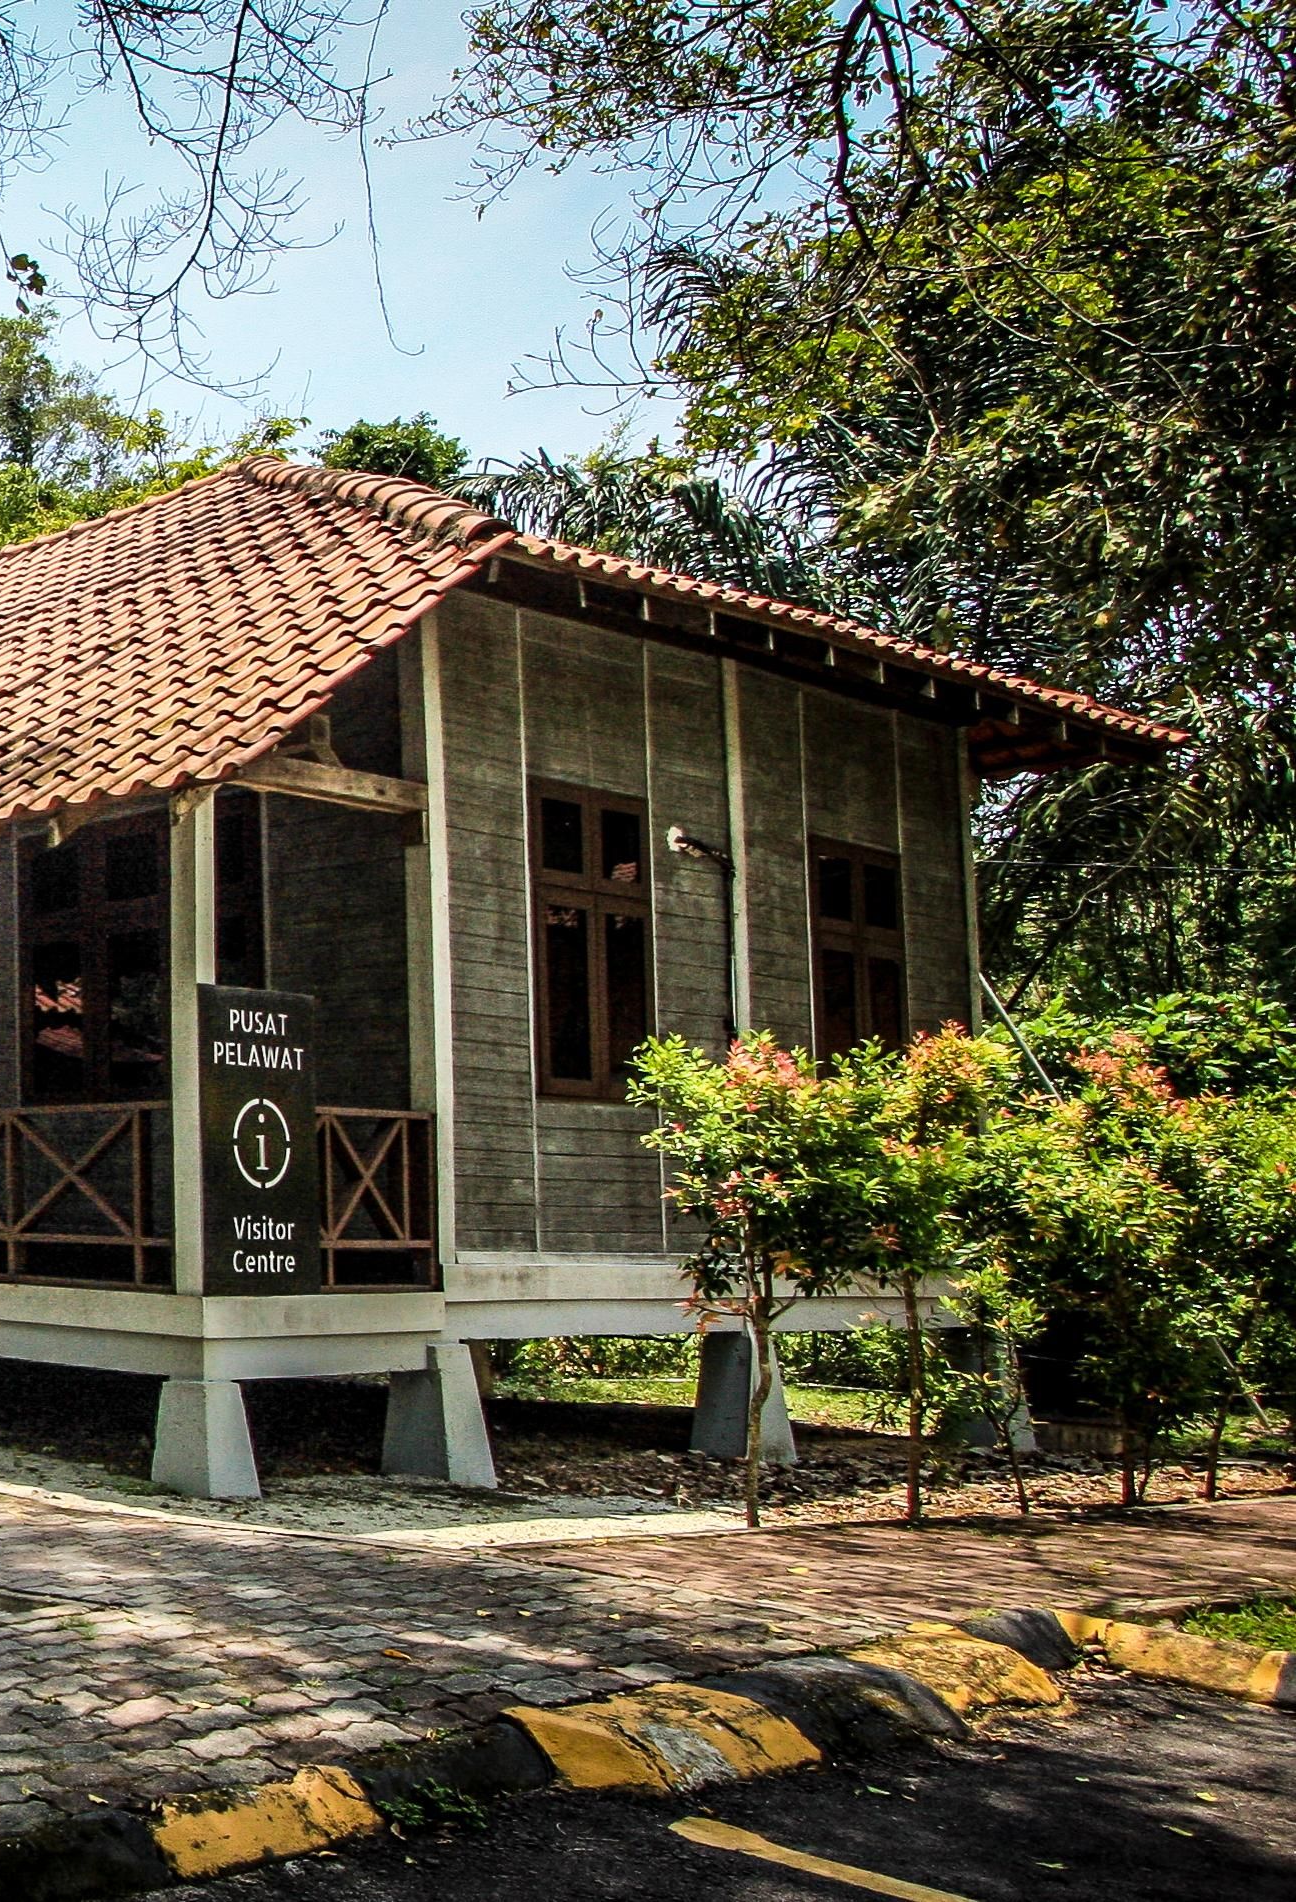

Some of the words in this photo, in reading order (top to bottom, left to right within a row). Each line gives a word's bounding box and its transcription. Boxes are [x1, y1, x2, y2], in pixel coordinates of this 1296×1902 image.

[229, 1009, 288, 1036] PUSAT
[213, 1041, 304, 1070] PELAWAT
[233, 1216, 295, 1241] Visitor
[232, 1249, 296, 1273] Centre
